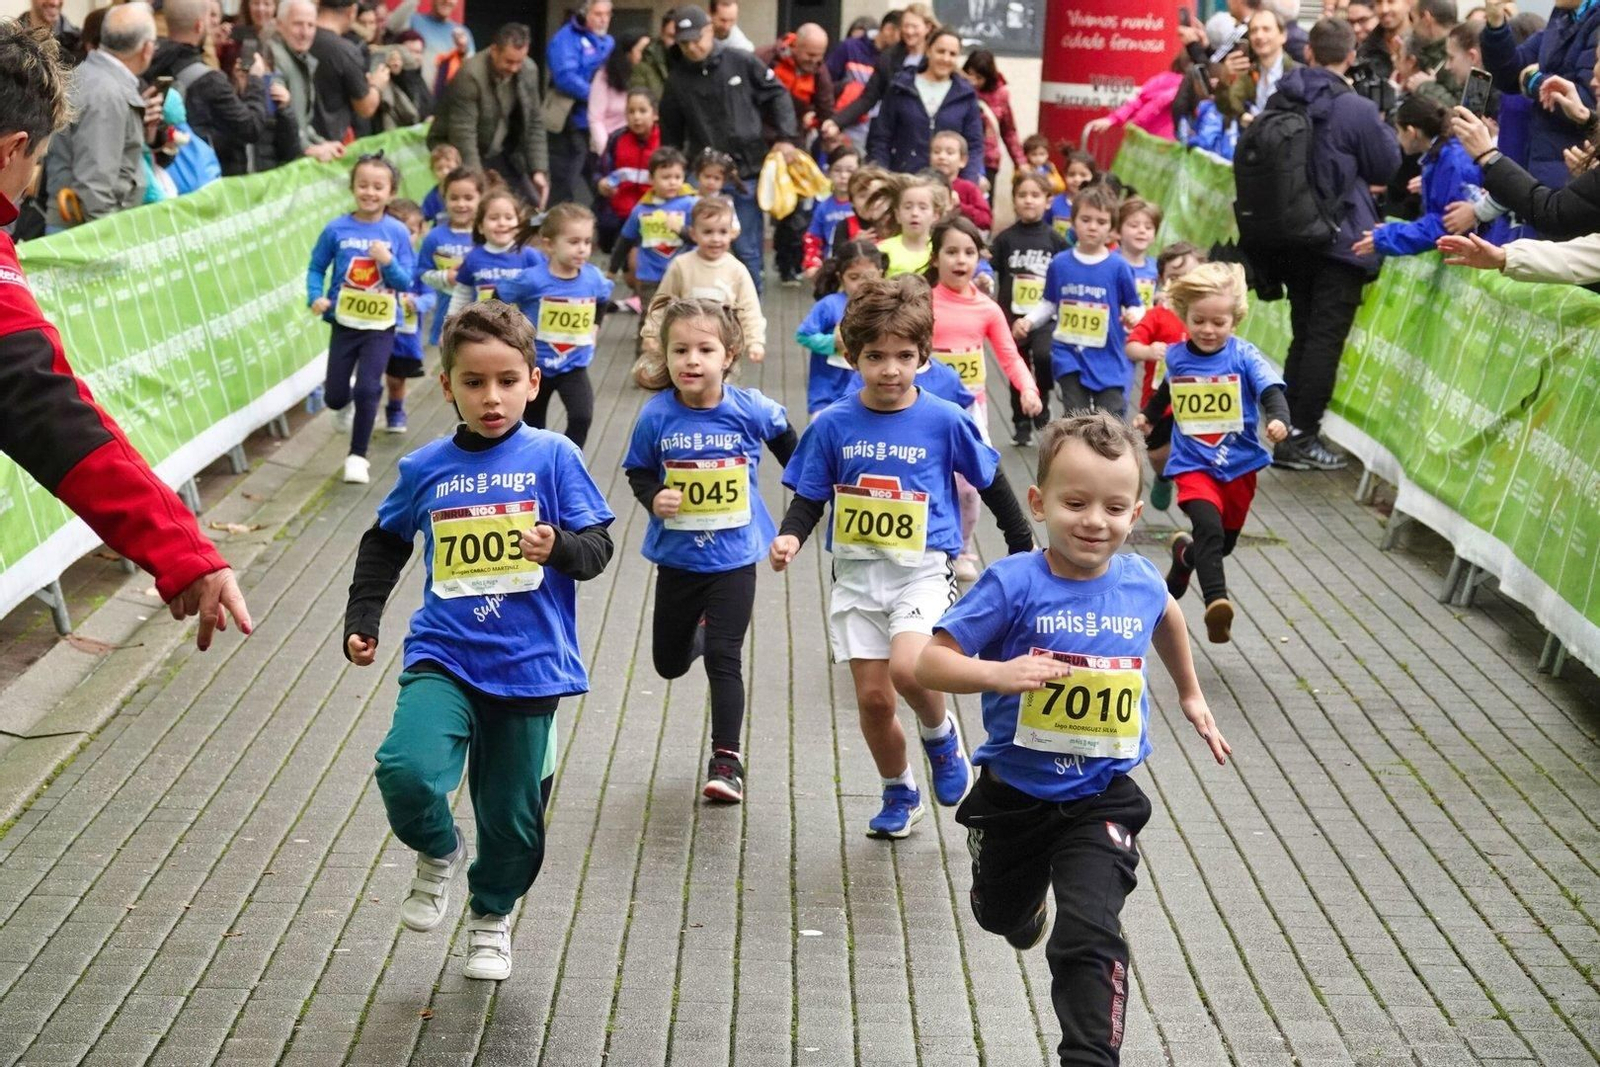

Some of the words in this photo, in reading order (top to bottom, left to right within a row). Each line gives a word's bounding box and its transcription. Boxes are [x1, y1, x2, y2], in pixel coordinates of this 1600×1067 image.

[346, 297, 388, 316] 7002
[548, 311, 591, 328] 7026
[1064, 313, 1101, 332] 7019
[1177, 393, 1232, 413] 7020
[661, 433, 692, 451] máis
[705, 433, 742, 450] auga
[842, 441, 875, 460] máis
[889, 445, 927, 464] auga
[436, 475, 475, 498] máis
[491, 472, 536, 492] auga
[673, 480, 739, 506] 7045
[844, 508, 914, 539] 7008
[440, 530, 525, 567] 7003
[1036, 610, 1084, 634] máis
[1101, 615, 1143, 640] auga
[1042, 682, 1133, 723] 7010
